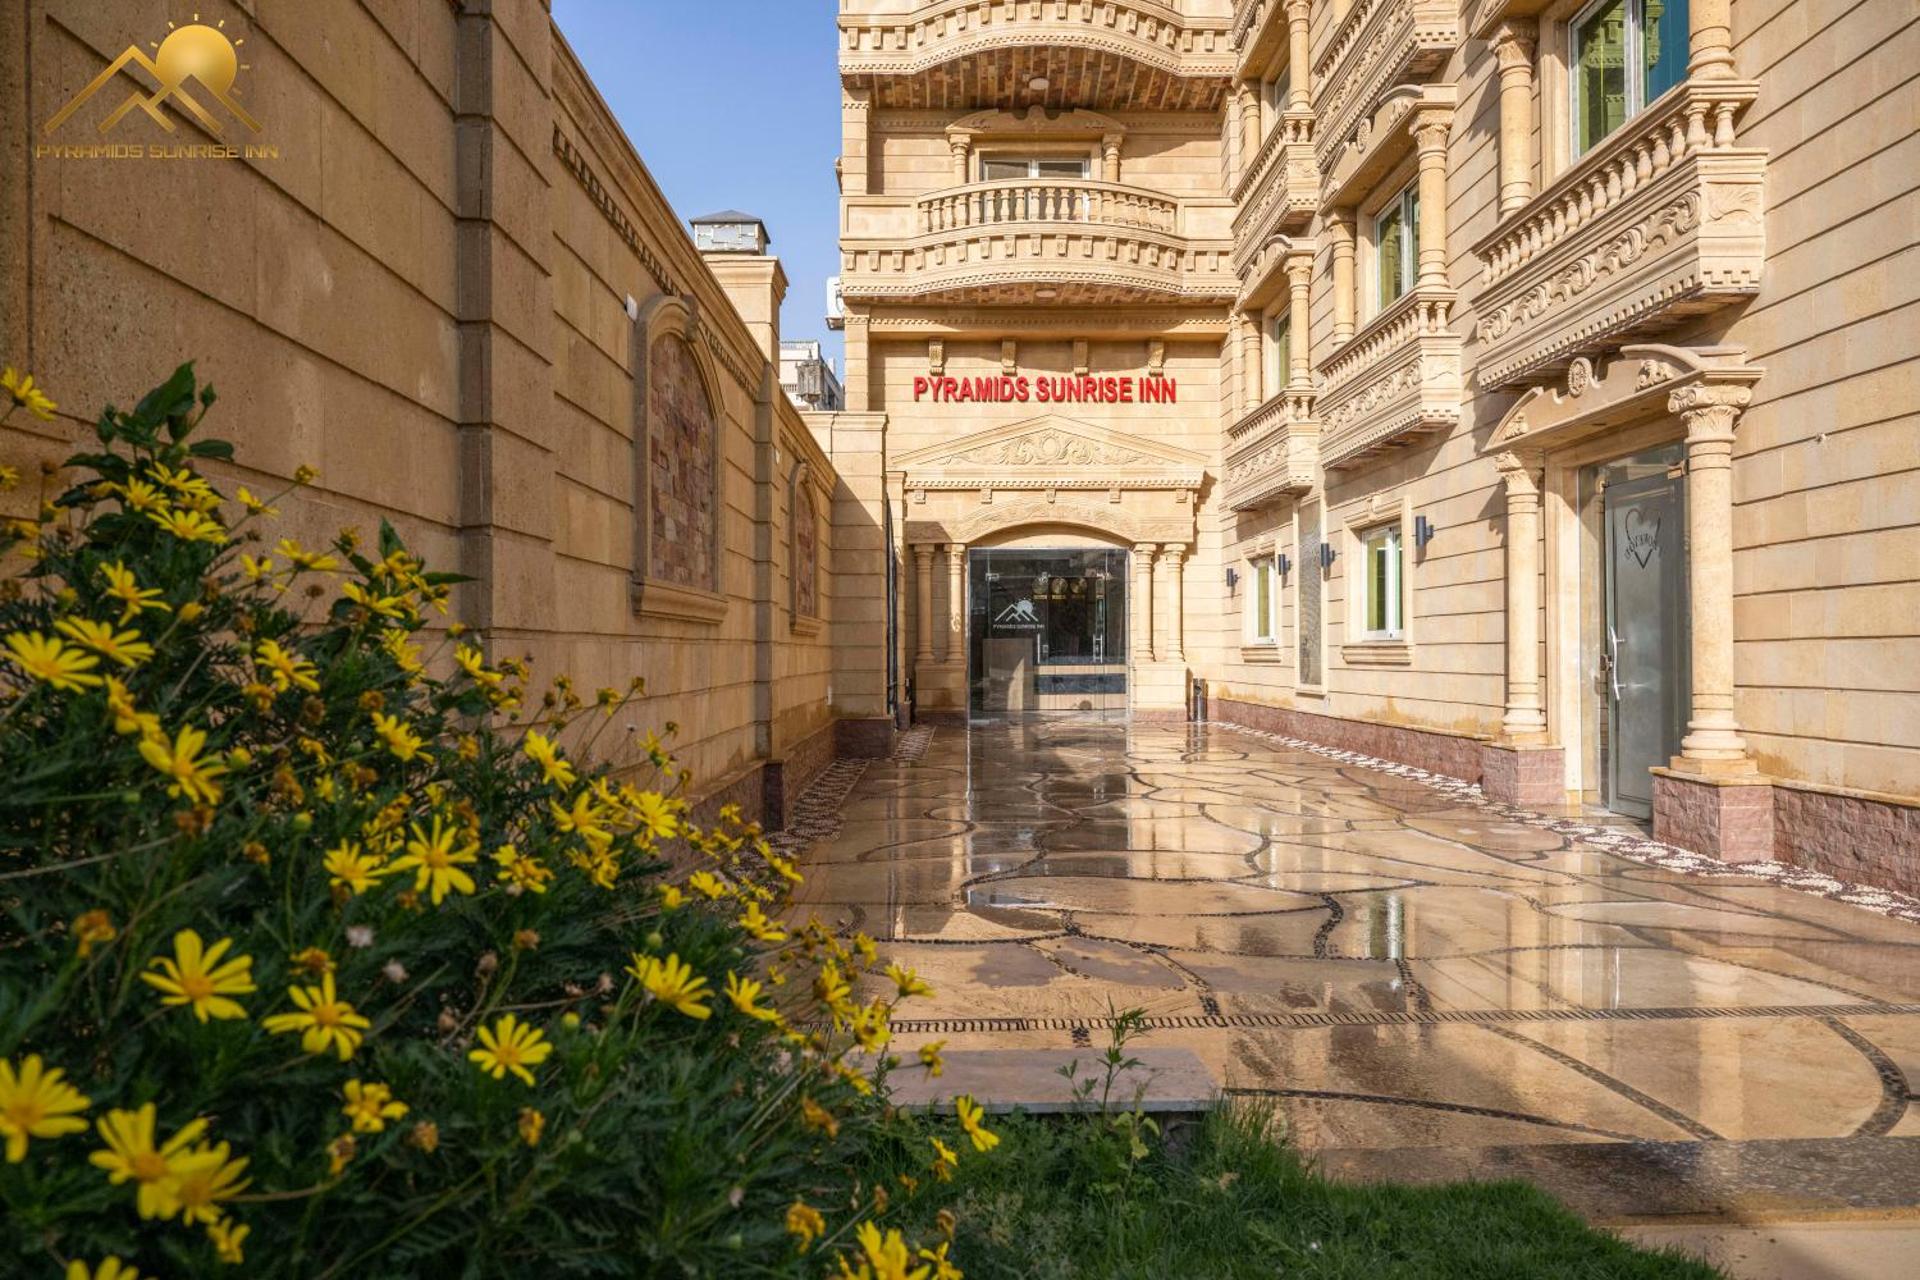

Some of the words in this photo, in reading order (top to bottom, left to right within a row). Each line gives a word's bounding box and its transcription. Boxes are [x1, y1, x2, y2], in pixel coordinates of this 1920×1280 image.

[913, 376, 1030, 403] PYRAMIDS
[1035, 376, 1133, 403] SUNRISE
[1139, 376, 1177, 404] INN
